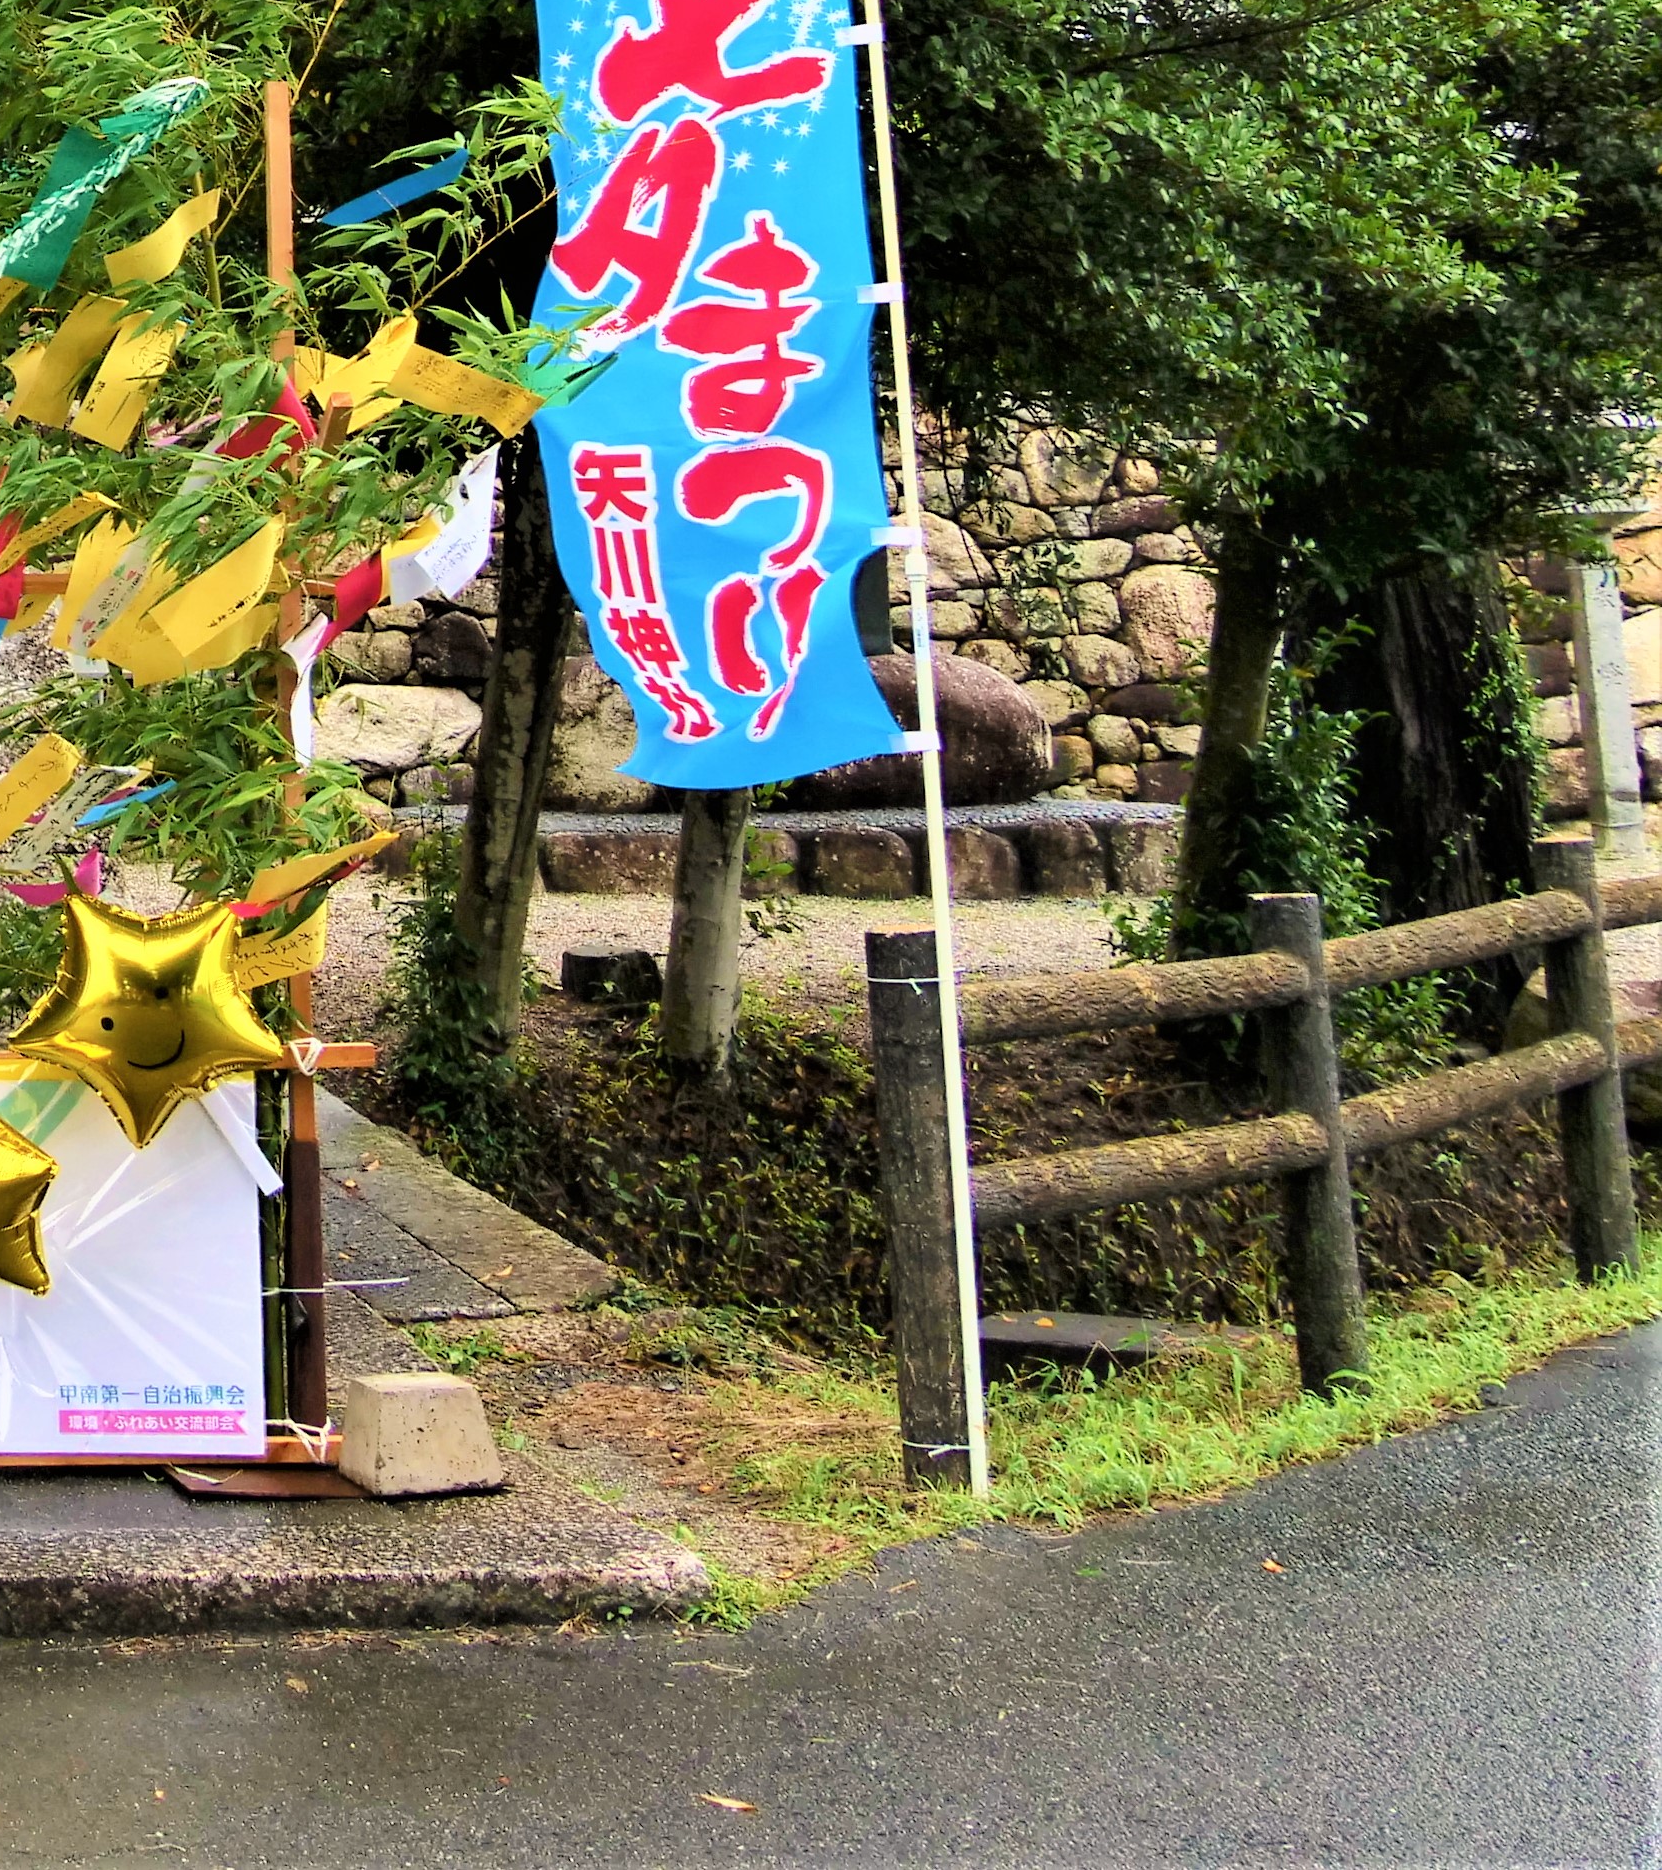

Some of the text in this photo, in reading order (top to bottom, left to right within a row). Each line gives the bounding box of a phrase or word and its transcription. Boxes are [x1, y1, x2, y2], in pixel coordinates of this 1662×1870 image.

[59, 1384, 245, 1406] 甲南第一自治振興会
